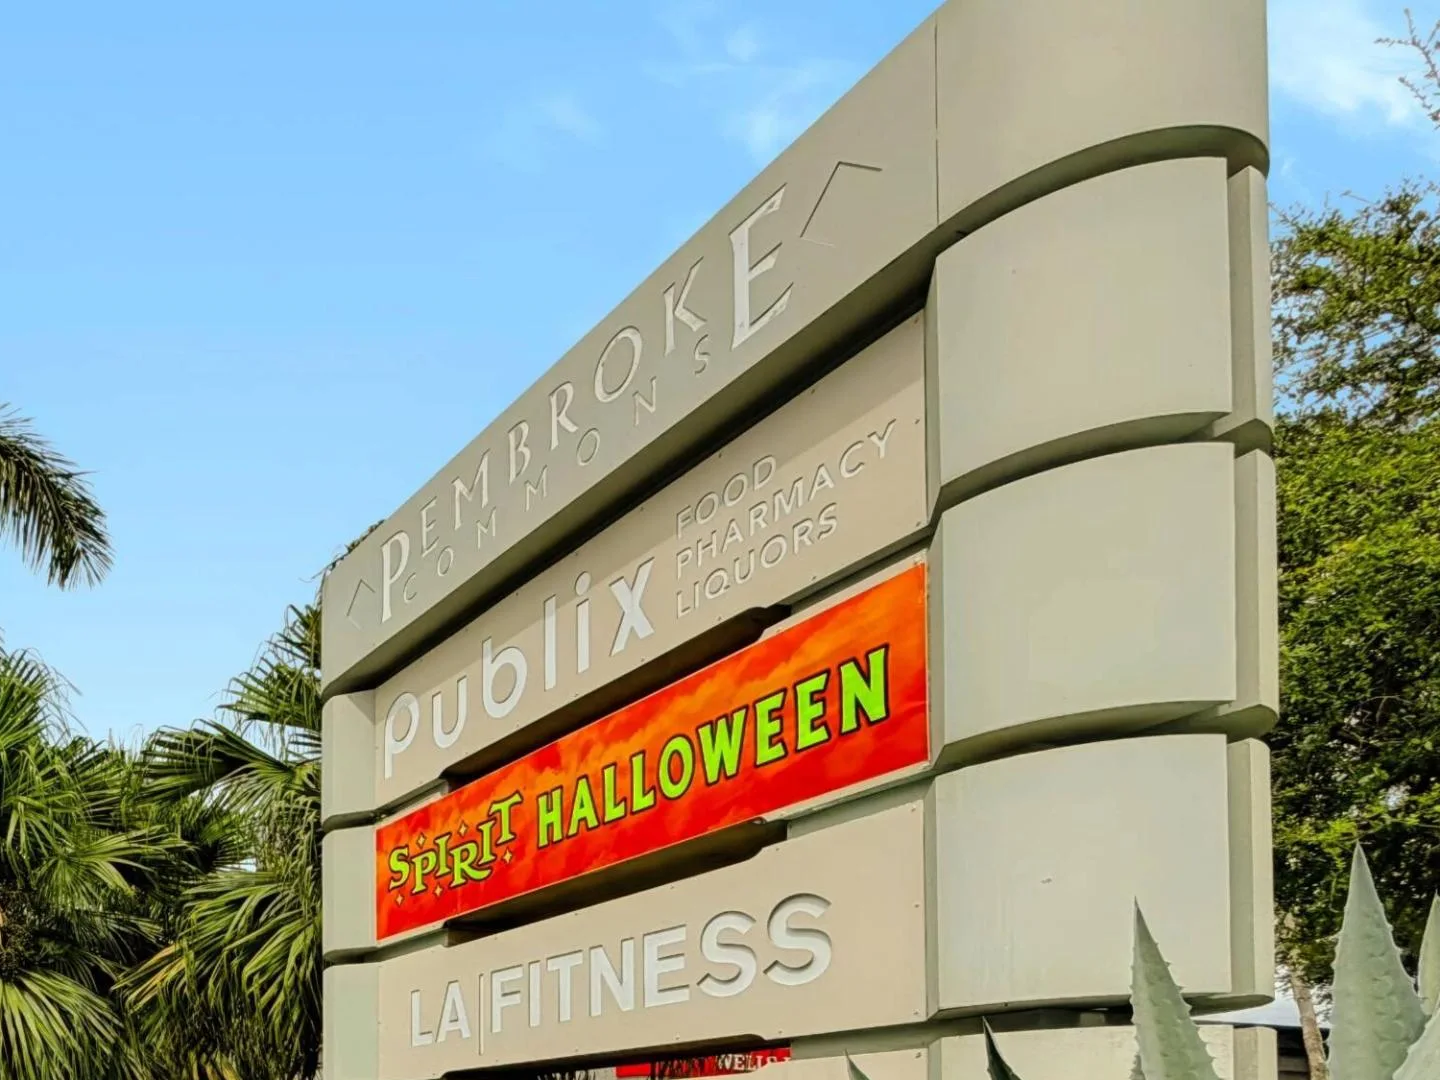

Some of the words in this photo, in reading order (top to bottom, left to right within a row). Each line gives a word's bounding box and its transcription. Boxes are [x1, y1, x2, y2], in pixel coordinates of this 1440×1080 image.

[379, 182, 794, 624] PEMBROKE
[402, 334, 712, 605] COMMONS
[676, 454, 777, 539] FOOD
[676, 418, 898, 580] PHARMACY
[676, 502, 839, 619] LIQUORS
[388, 791, 522, 896] SPIRIT
[535, 642, 891, 849] HALLOWEEN
